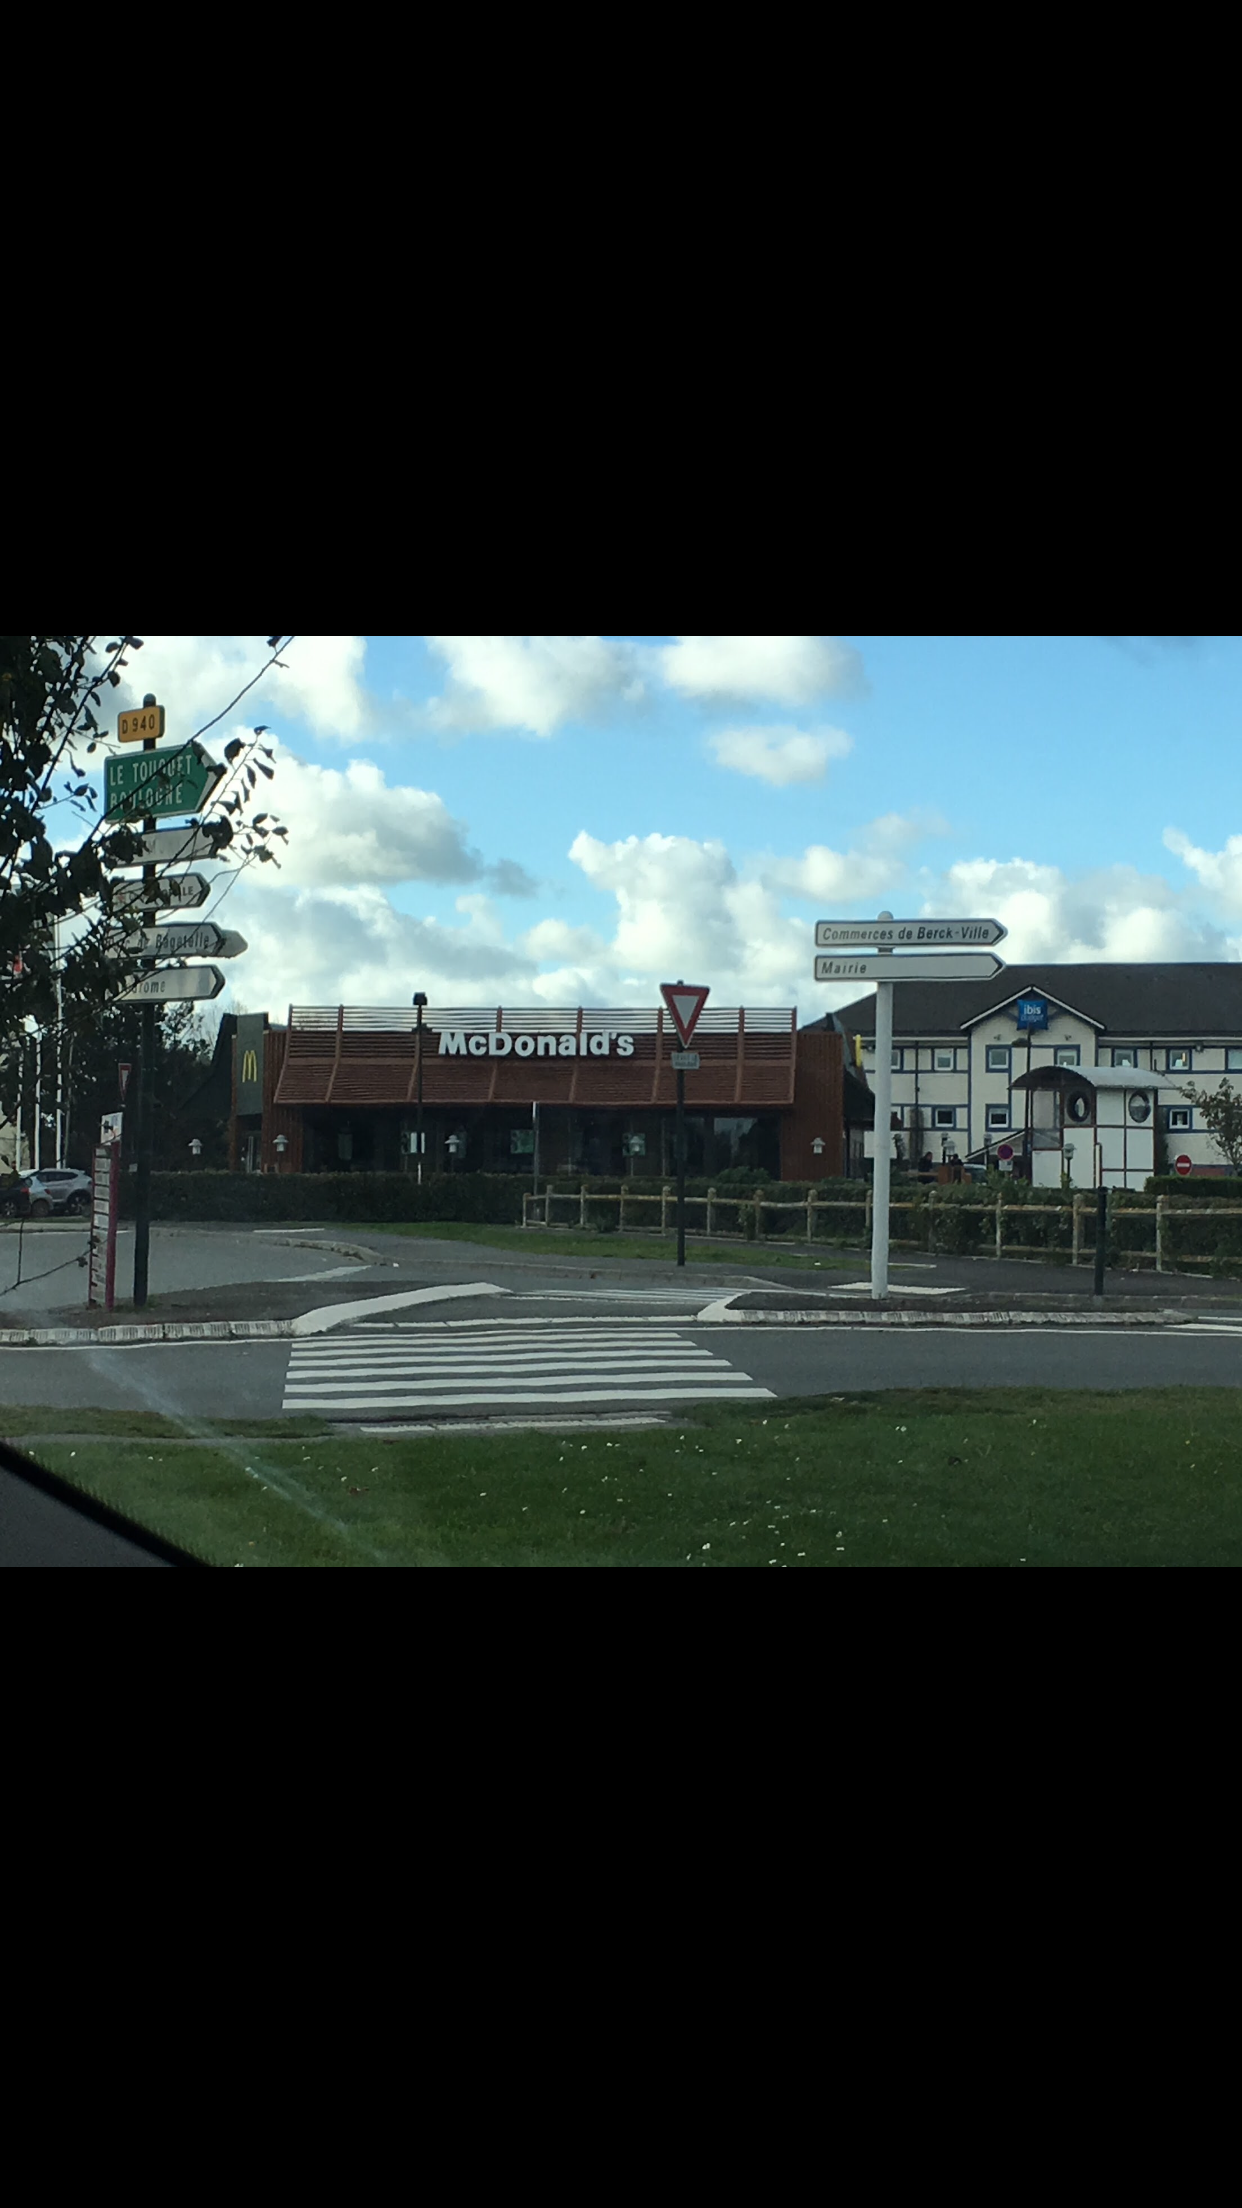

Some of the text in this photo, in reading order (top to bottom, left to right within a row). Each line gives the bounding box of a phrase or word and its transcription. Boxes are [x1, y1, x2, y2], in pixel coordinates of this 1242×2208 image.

[122, 714, 155, 735] D 940
[110, 754, 192, 786] LE TOUQUET
[823, 927, 894, 941] Commerces
[898, 927, 912, 940] de
[821, 961, 867, 975] Mairie
[1023, 1004, 1042, 1015] ibis
[438, 1031, 635, 1057] McDonald's
